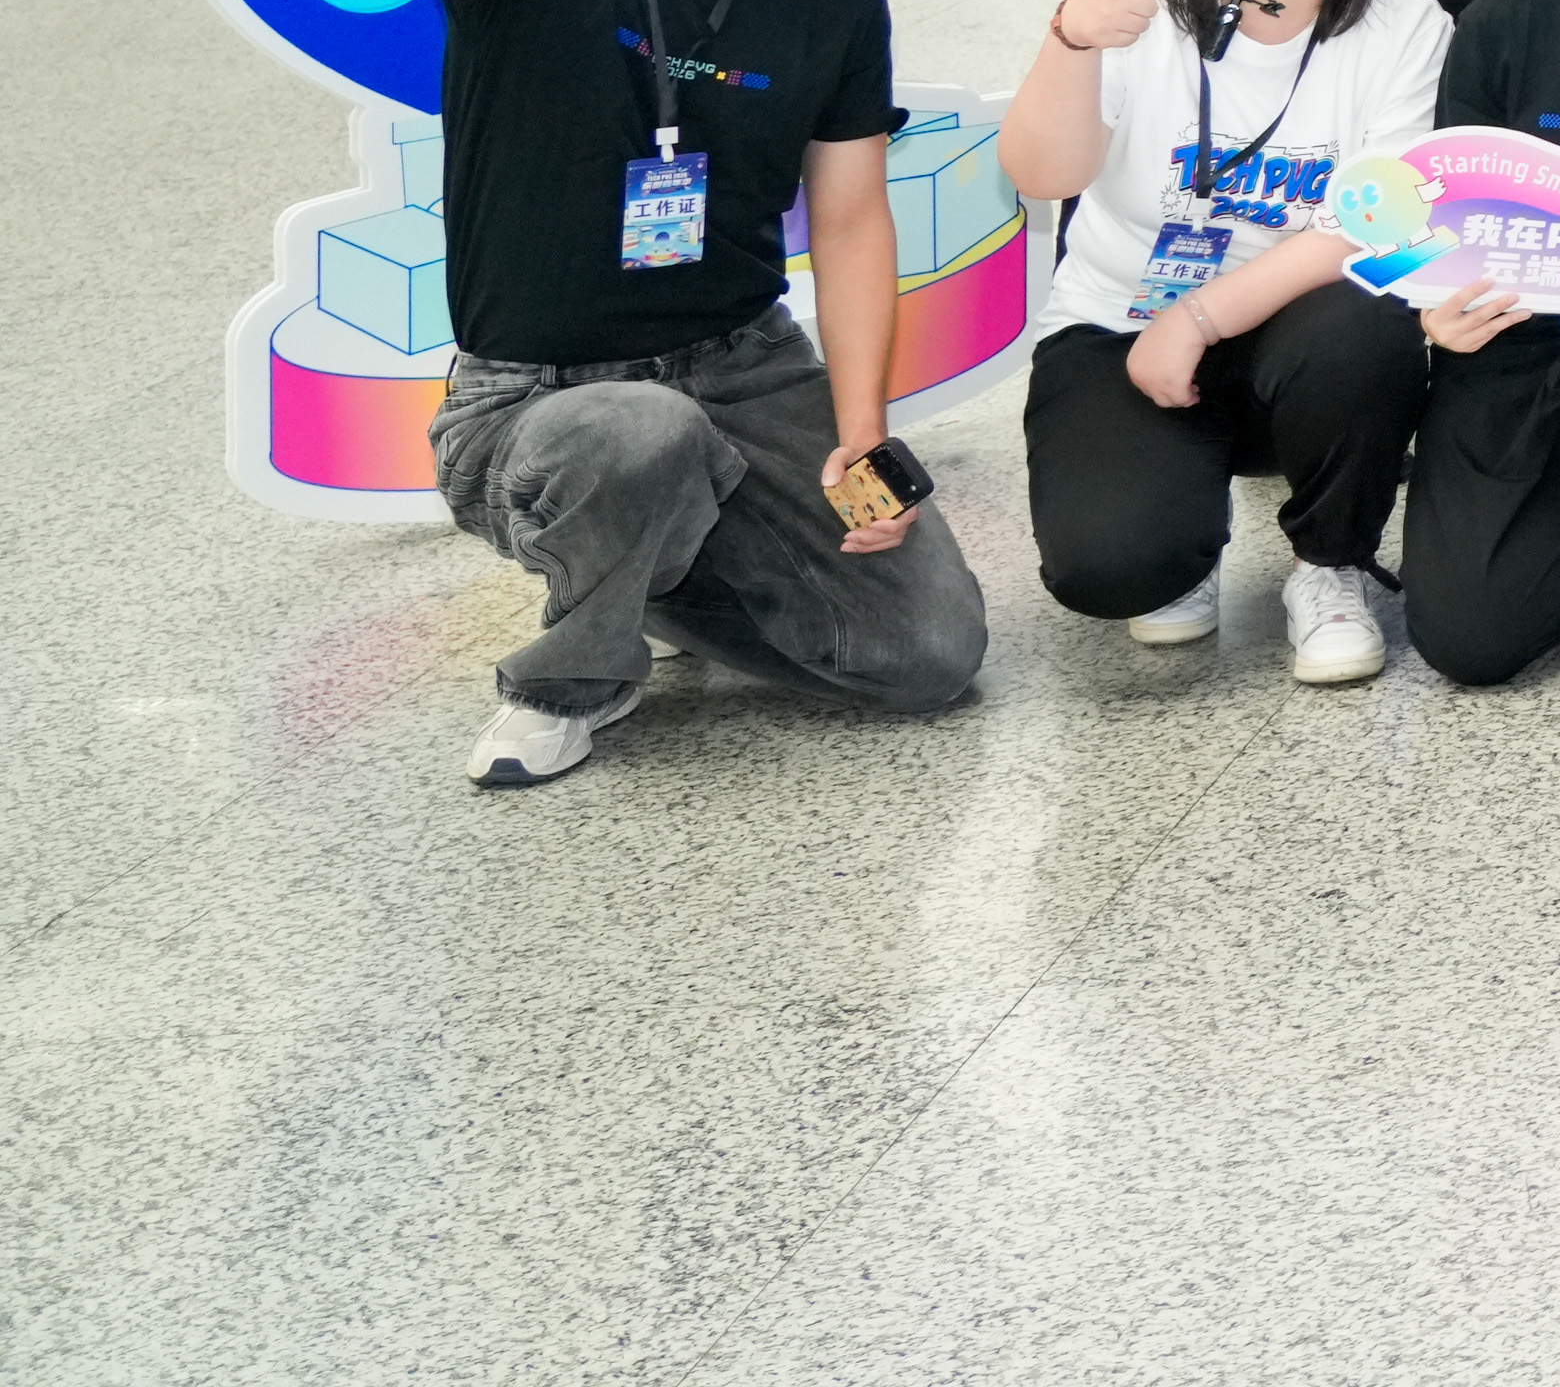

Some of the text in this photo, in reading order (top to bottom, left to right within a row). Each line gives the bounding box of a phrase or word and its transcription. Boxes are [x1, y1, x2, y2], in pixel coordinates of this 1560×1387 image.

[1261, 156, 1335, 204] PVG
[1430, 155, 1530, 184] Starting
[635, 197, 697, 218] 工作证
[1209, 195, 1288, 228] 2026
[1152, 261, 1210, 280] 工作证
